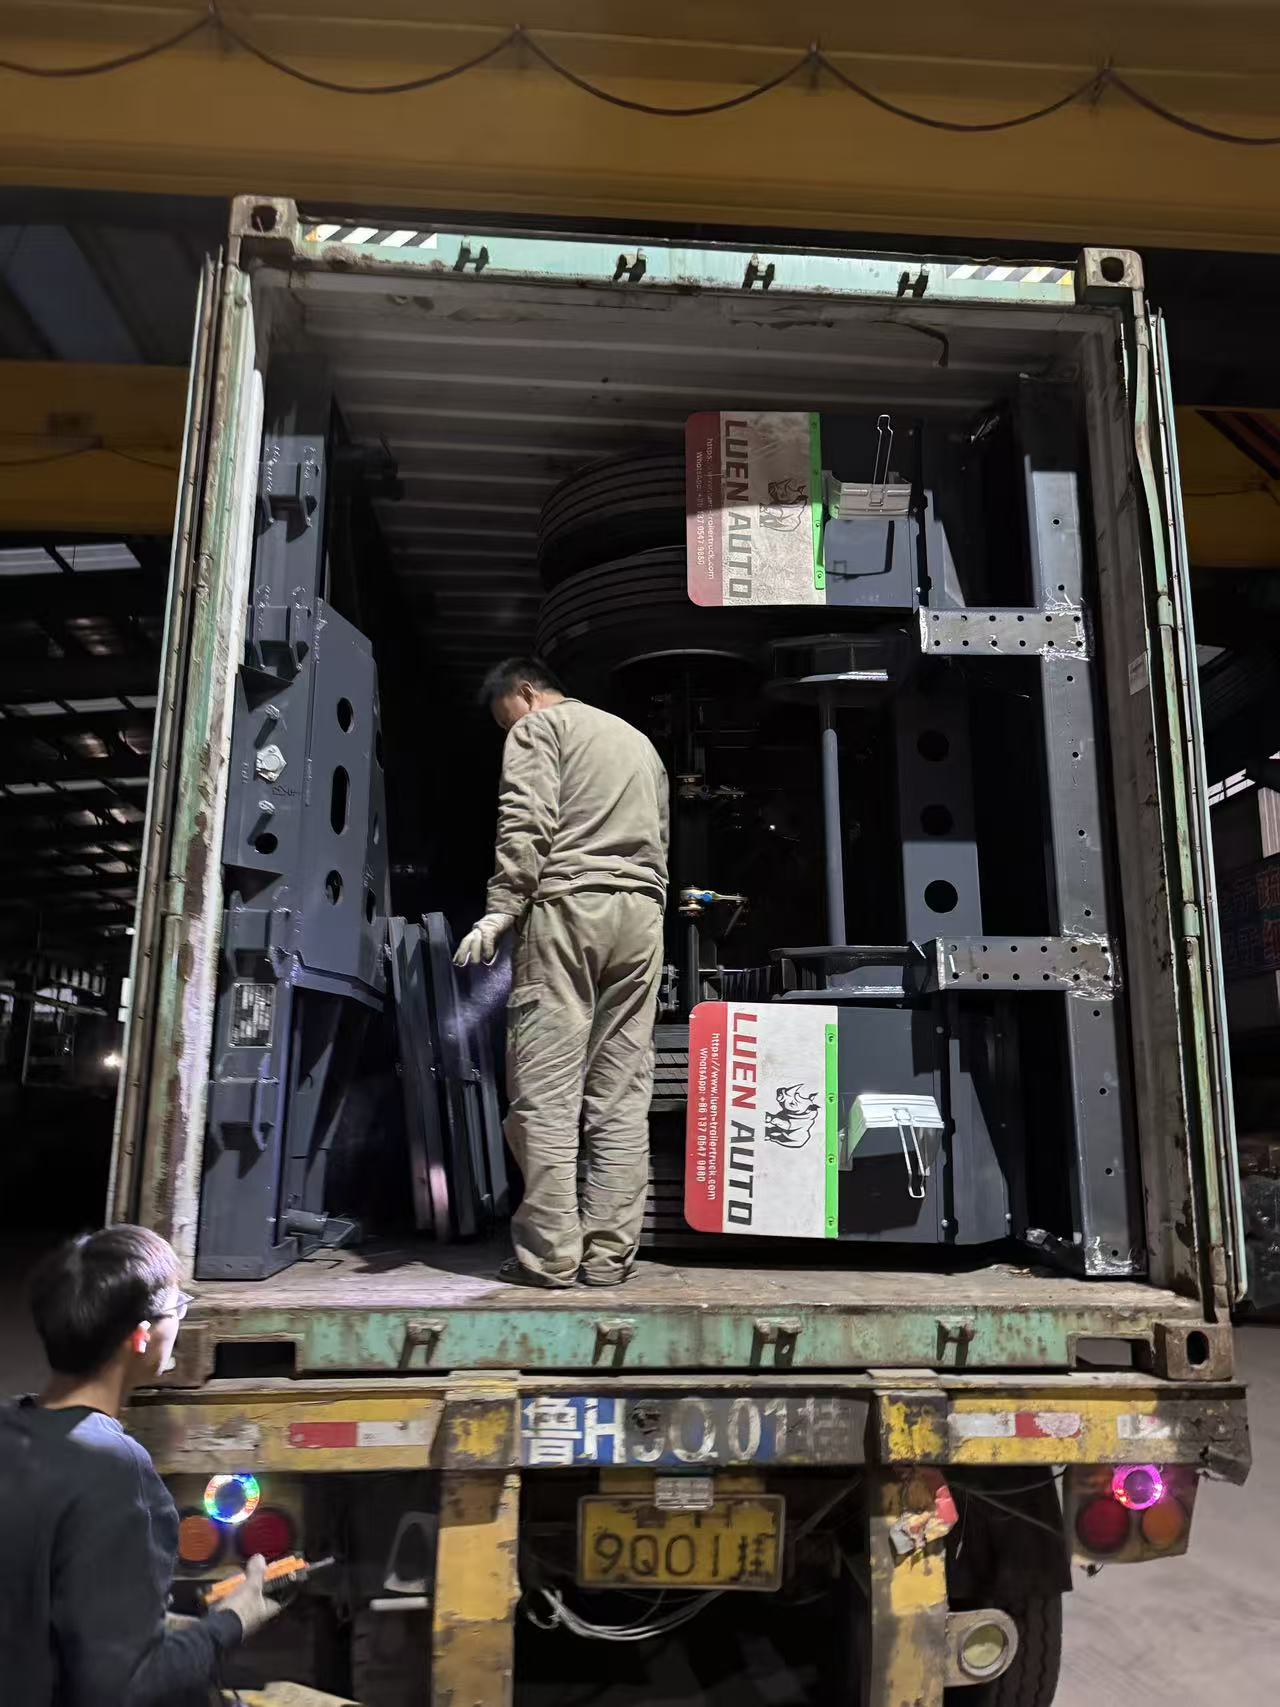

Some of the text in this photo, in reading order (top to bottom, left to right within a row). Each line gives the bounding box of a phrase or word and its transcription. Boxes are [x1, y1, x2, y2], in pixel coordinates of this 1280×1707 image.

[725, 420, 752, 599] LUEN AUTO
[698, 1047, 708, 1094] WhatsApp:
[698, 1096, 707, 1113] +86
[698, 1116, 707, 1132] 137
[708, 1033, 721, 1200] https://www.luen-trailertruck.com
[728, 1012, 758, 1226] LUEN AUTO
[697, 1135, 707, 1157] 0547
